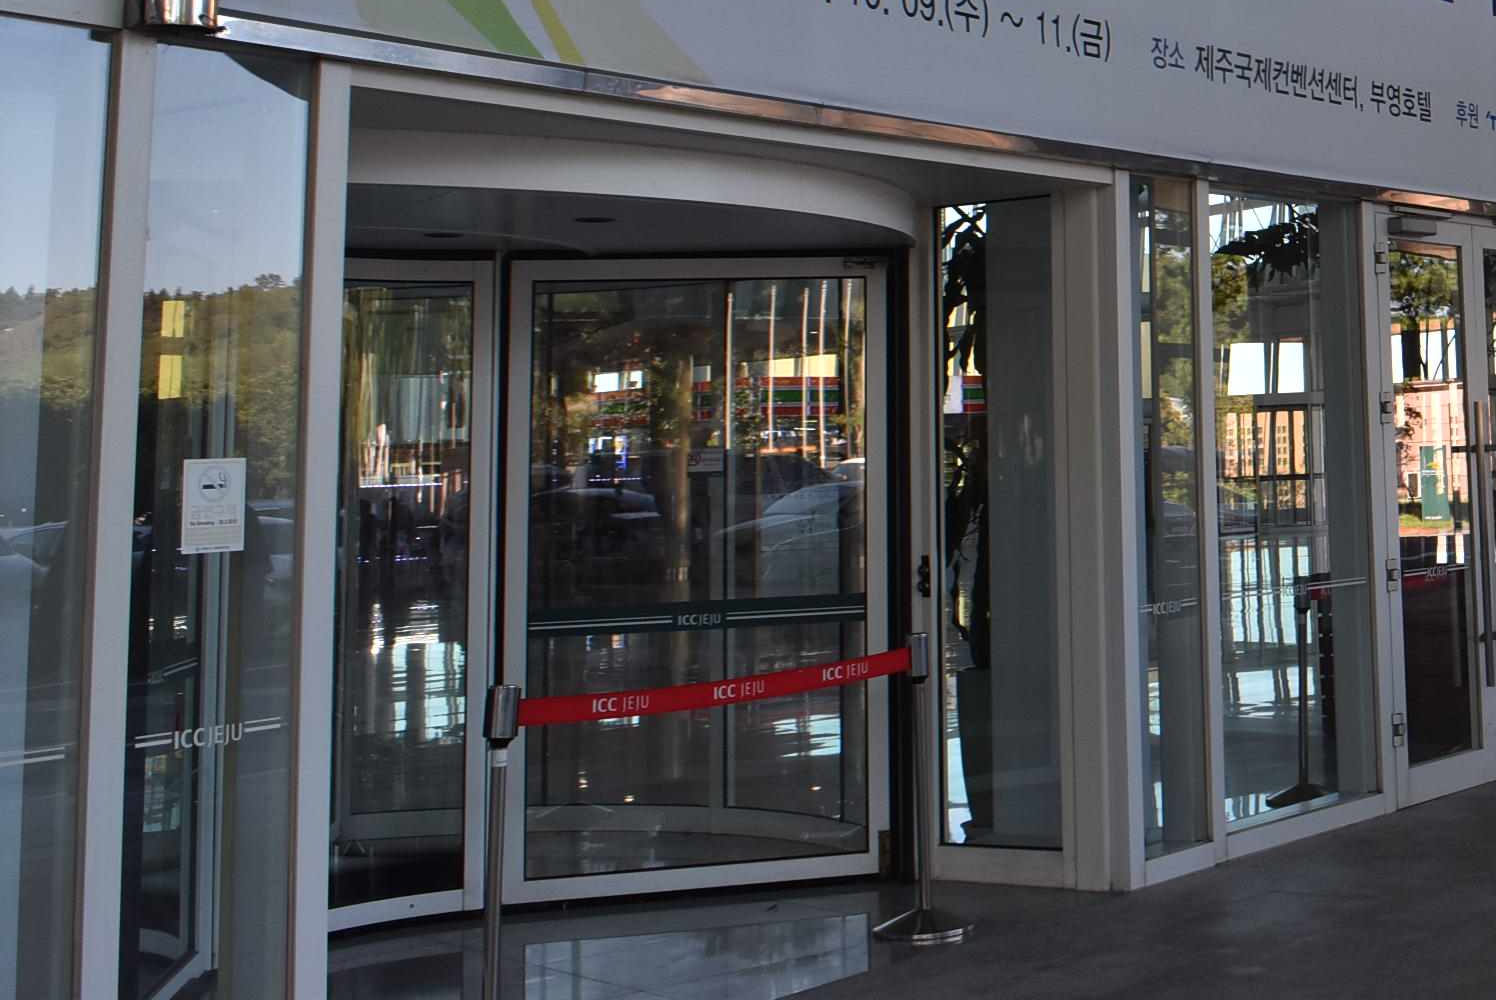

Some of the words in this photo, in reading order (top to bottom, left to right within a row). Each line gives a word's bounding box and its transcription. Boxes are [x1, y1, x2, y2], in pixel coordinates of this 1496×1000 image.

[1036, 11, 1112, 63] 11.(금)
[1151, 37, 1185, 69] 장소
[1195, 44, 1364, 112] 제주국제컨벤션센터,
[1369, 80, 1432, 123] 부영호텔
[1456, 100, 1479, 129] 후원
[822, 666, 843, 681] ICC
[845, 661, 869, 680] JEJU
[713, 684, 736, 700] ICC
[740, 680, 765, 698] JEJU
[592, 698, 617, 713] ICC
[622, 695, 650, 713] JEJU
